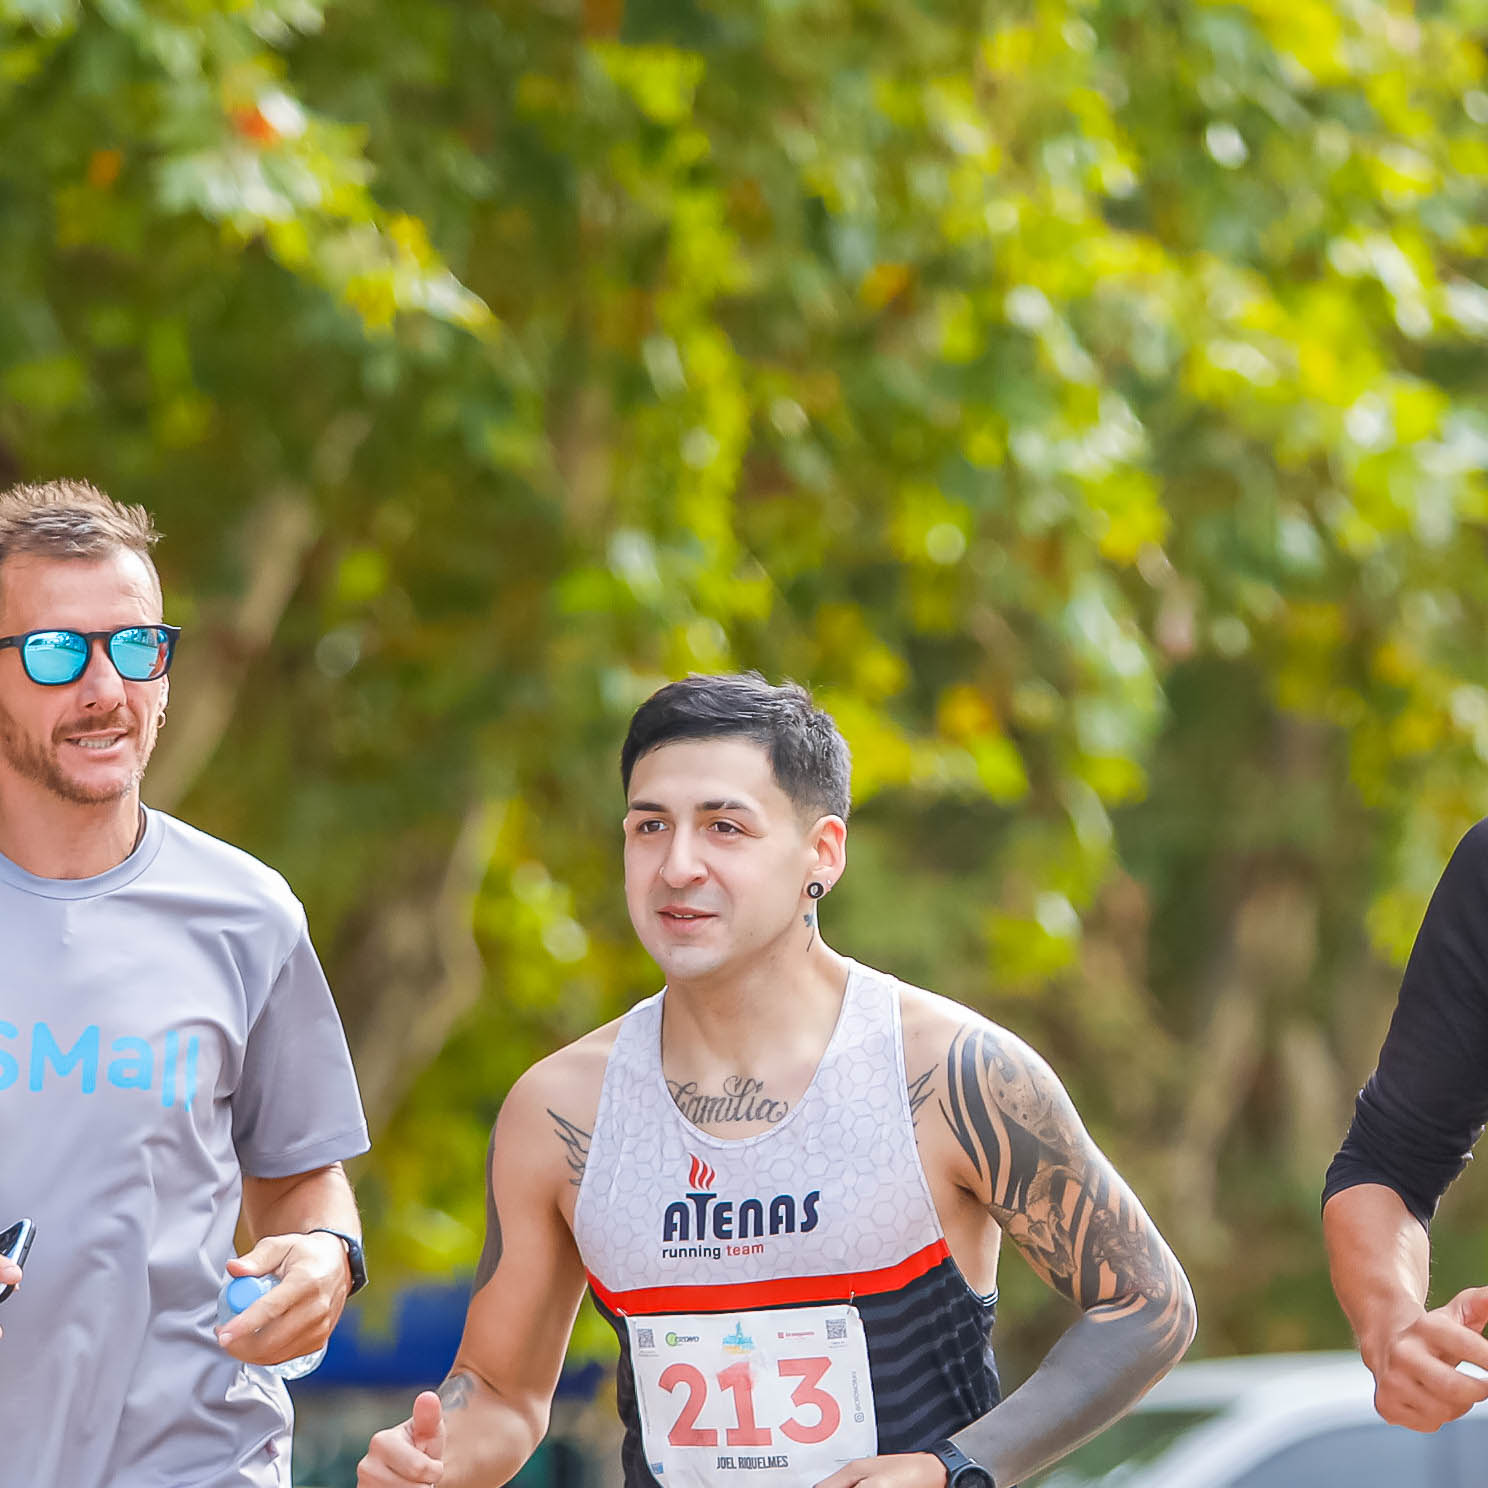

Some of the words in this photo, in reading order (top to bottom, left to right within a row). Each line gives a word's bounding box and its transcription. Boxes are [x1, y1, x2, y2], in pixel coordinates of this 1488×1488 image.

[663, 1190, 821, 1242] ATENAS
[662, 1244, 721, 1260] running
[726, 1243, 764, 1257] team
[658, 1356, 841, 1447] 213
[716, 1456, 737, 1470] JOEL
[738, 1455, 789, 1470] RIQUELMES
